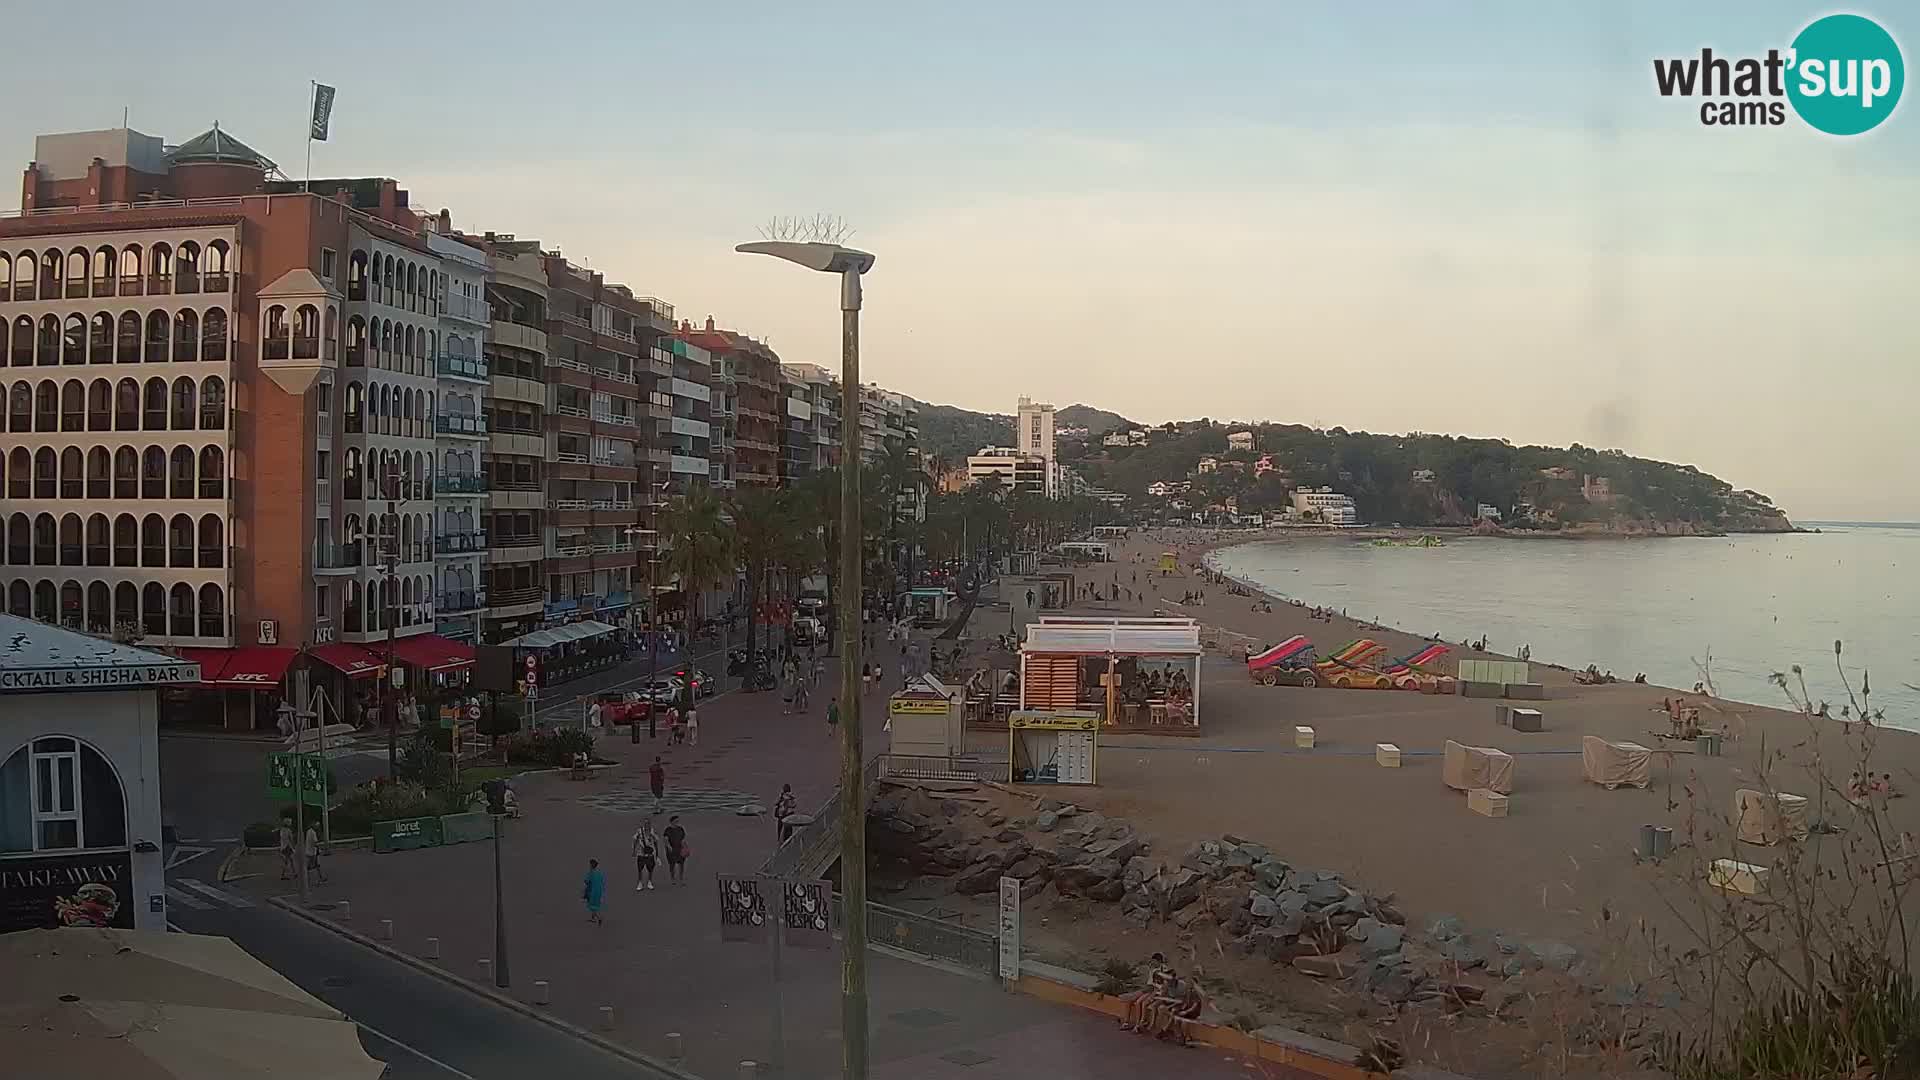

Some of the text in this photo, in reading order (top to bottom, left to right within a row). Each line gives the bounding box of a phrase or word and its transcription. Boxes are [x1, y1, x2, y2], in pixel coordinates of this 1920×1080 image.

[315, 625, 335, 643] KFC
[64, 671, 76, 684] &
[81, 669, 143, 684] SHISHA
[147, 667, 180, 682] BAR
[232, 672, 270, 681] KFC
